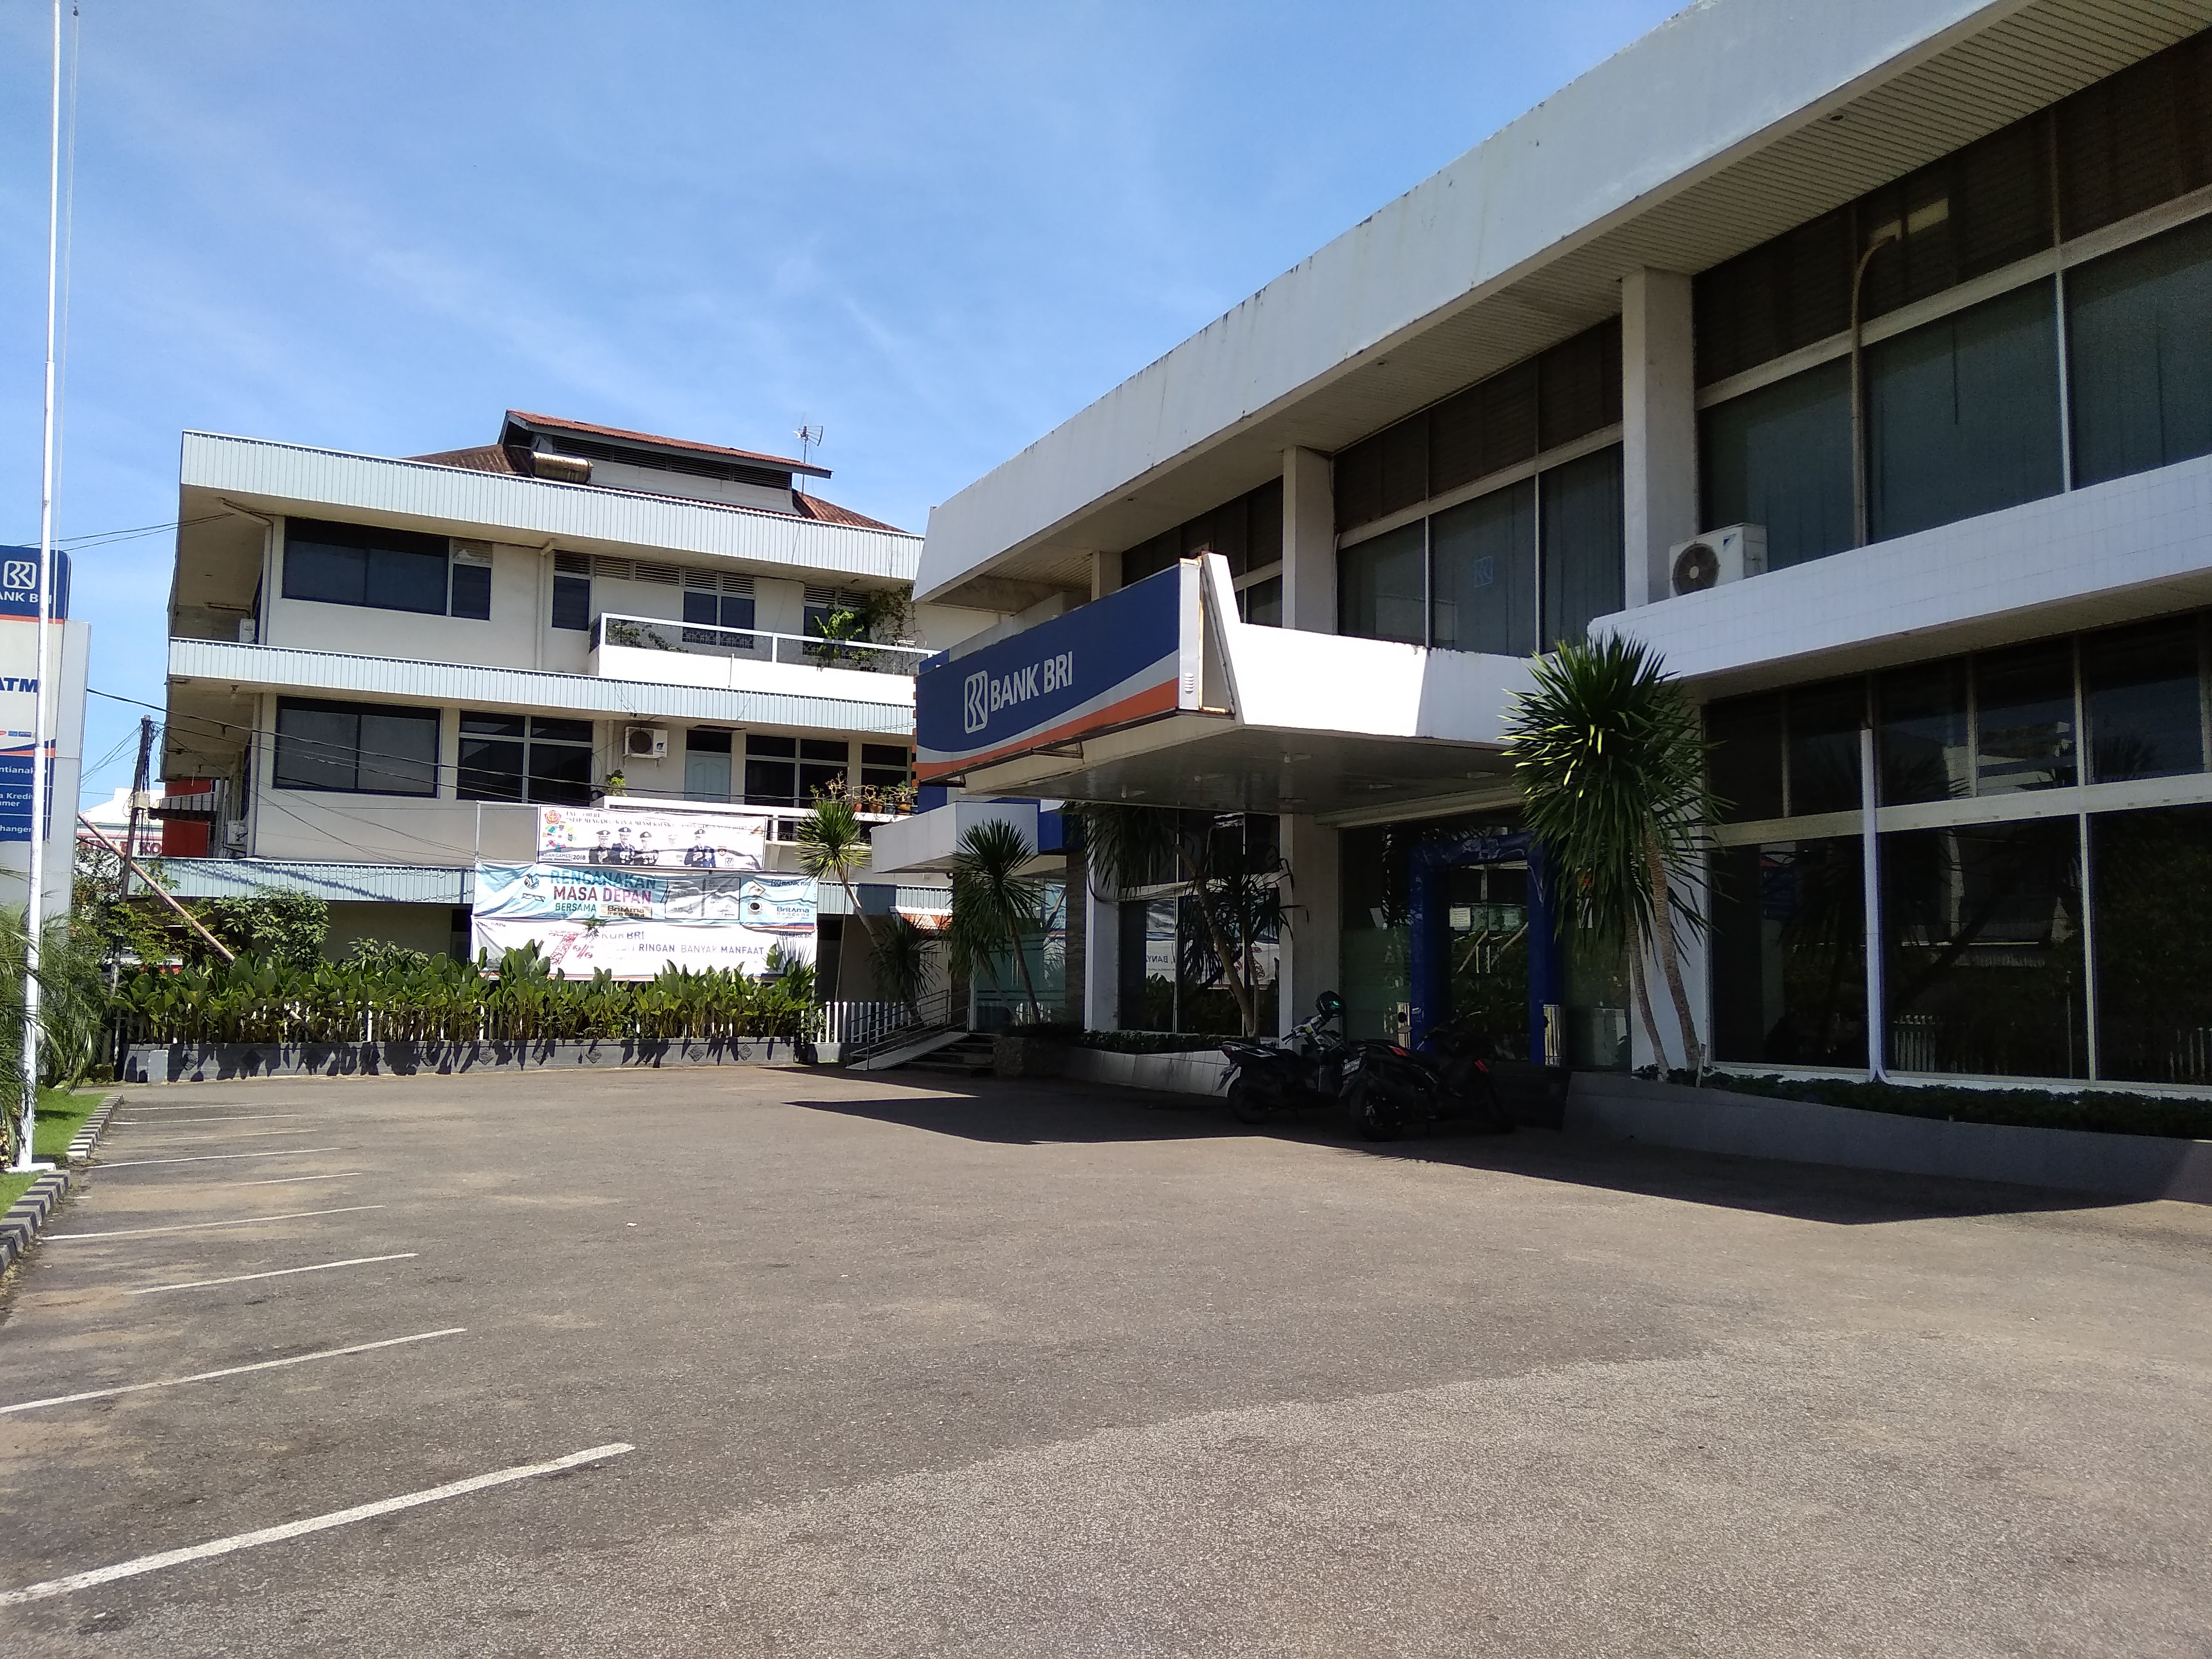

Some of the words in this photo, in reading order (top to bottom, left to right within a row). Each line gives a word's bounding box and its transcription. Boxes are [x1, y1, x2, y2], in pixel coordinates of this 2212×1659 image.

[29, 593, 52, 604] BI
[991, 663, 1040, 712] BANK
[1044, 651, 1073, 693] BRI
[550, 869, 657, 889] RENCANAKAN
[554, 886, 598, 901] MASA
[602, 887, 651, 904] DEPAN
[555, 902, 597, 912] BERSAMA
[626, 931, 644, 940] BRI
[639, 943, 675, 952] RINGAN
[681, 944, 717, 953] BANYAK
[721, 946, 764, 955] MANFAAT
